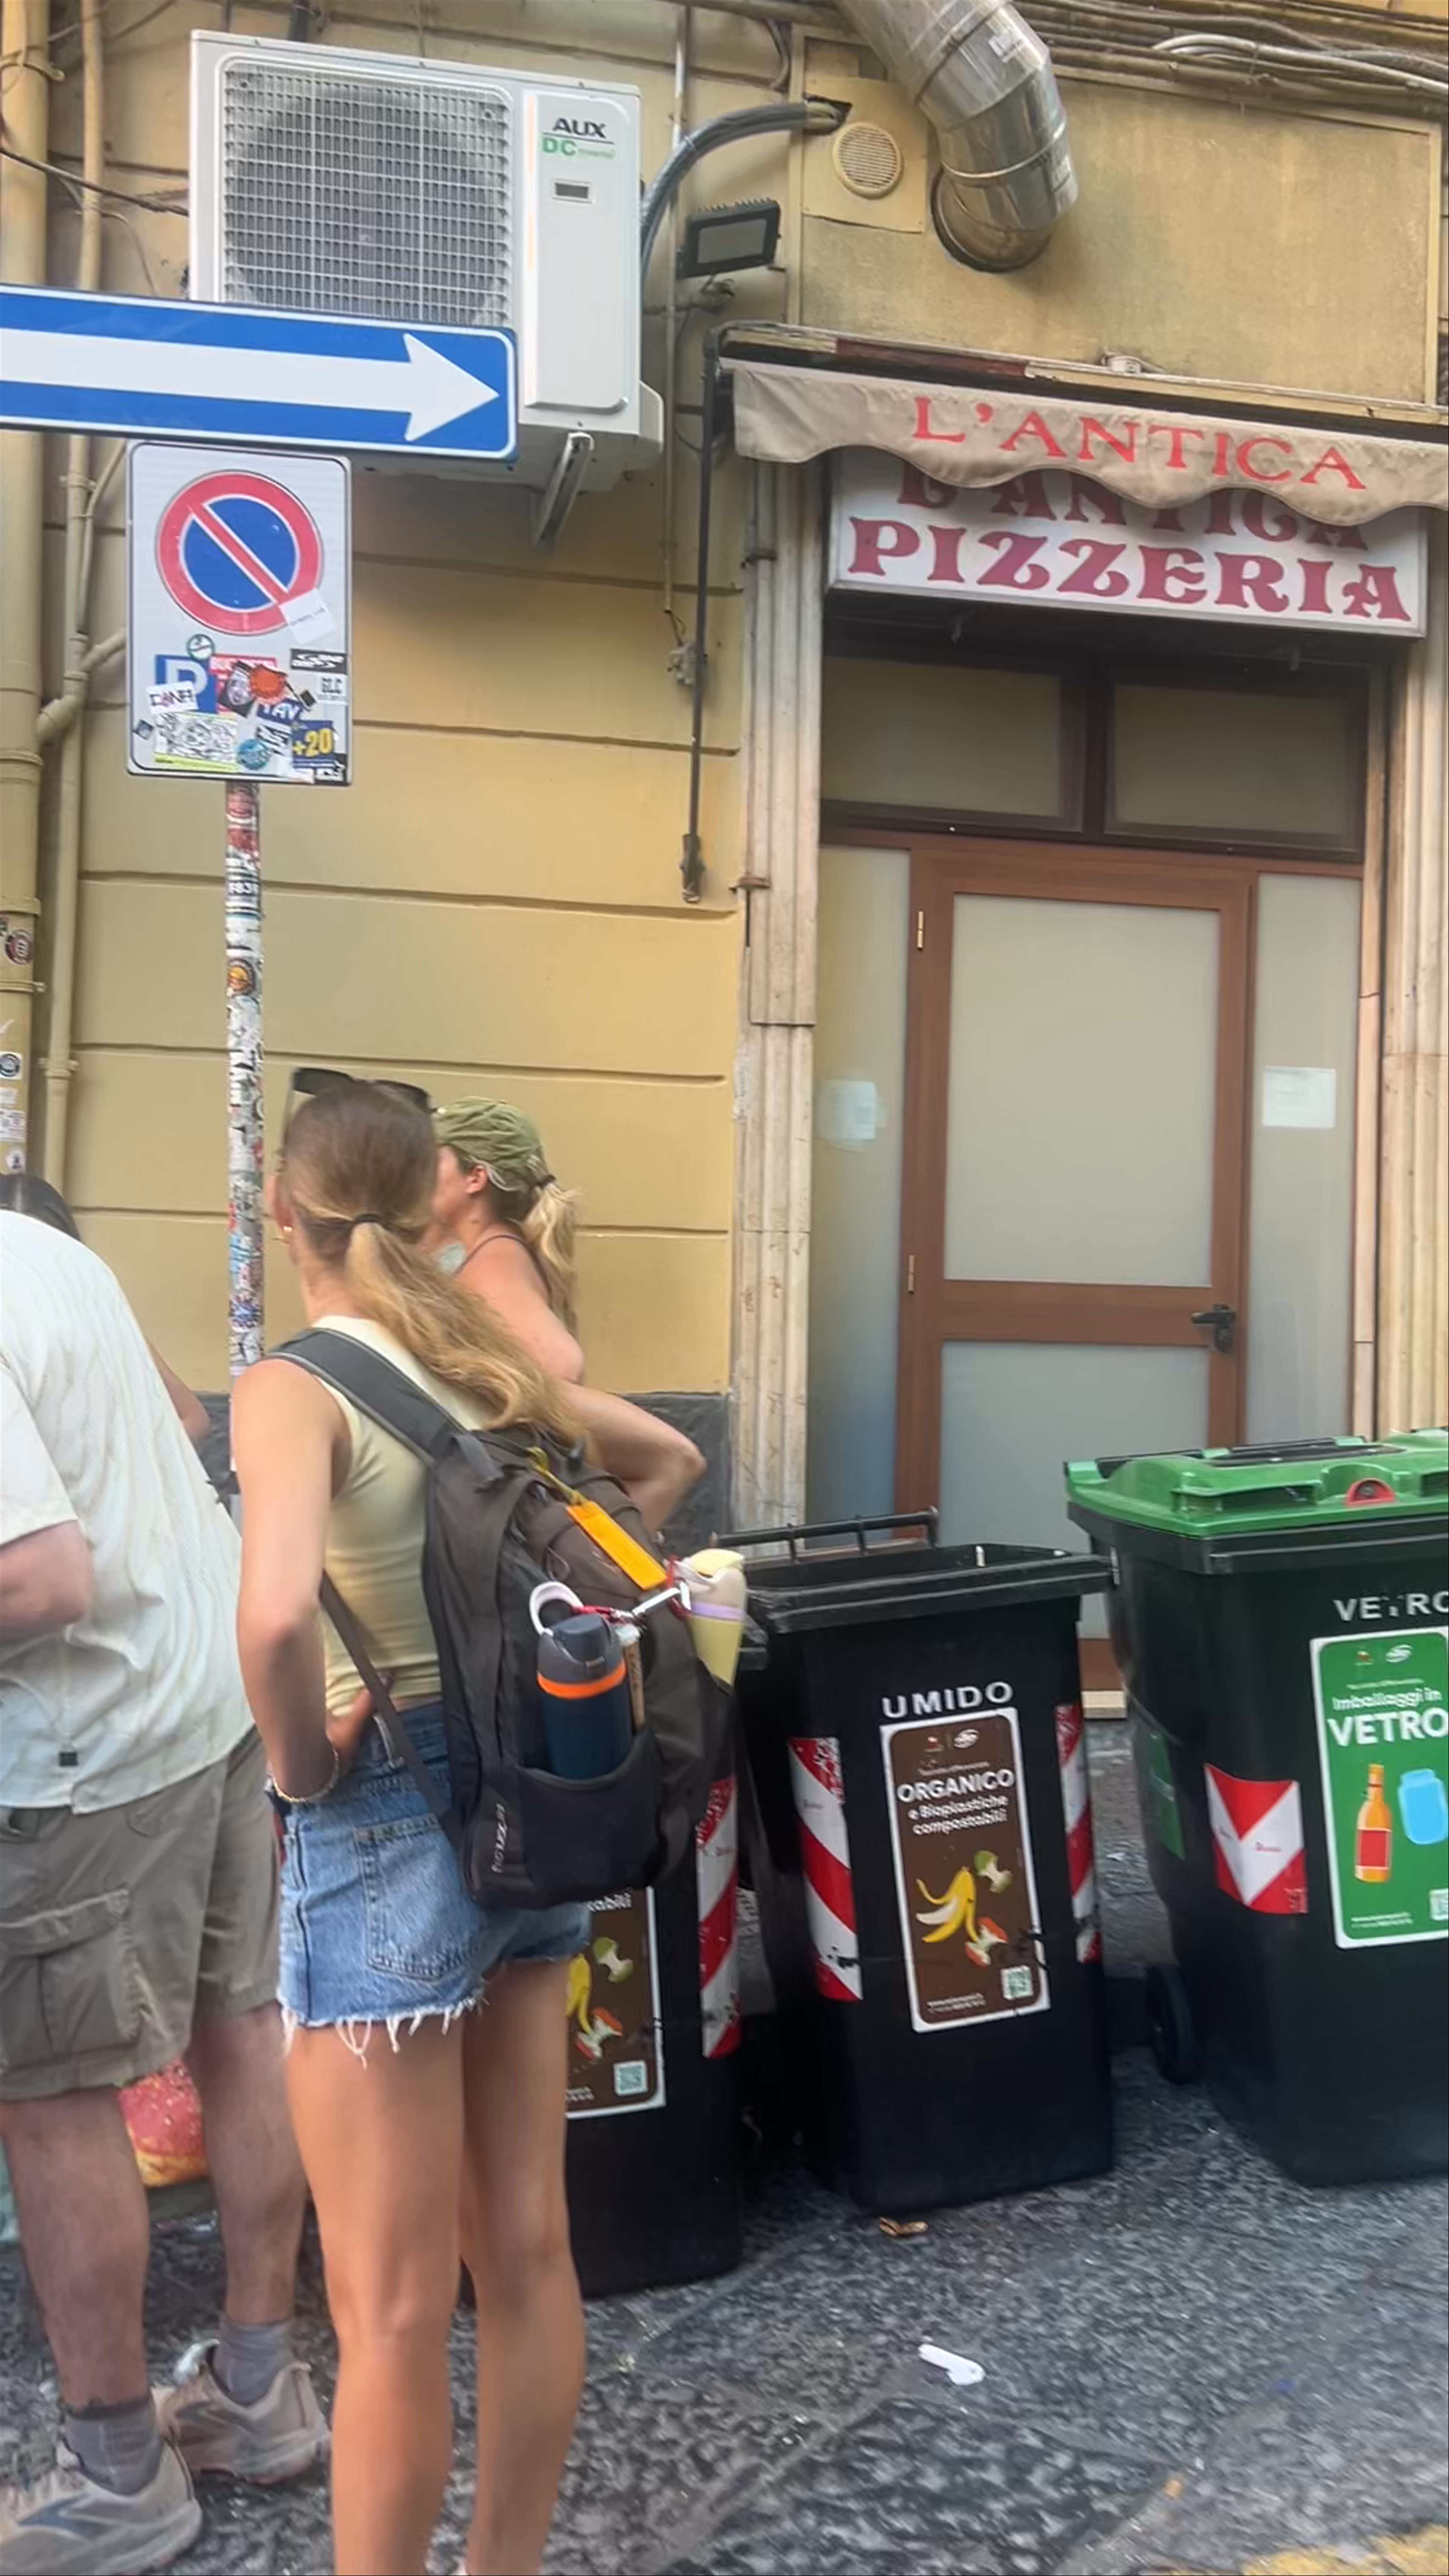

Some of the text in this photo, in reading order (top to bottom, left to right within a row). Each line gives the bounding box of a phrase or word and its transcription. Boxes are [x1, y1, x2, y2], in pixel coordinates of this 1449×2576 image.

[542, 137, 576, 156] DC
[552, 117, 606, 139] AUX
[912, 396, 1367, 491] L'ANTICA
[847, 516, 1411, 622] PIZZERIA
[882, 1681, 1013, 1718] UMIDO
[1326, 1707, 1449, 1747] VETRO
[897, 1769, 1015, 1803] ORGANICO
